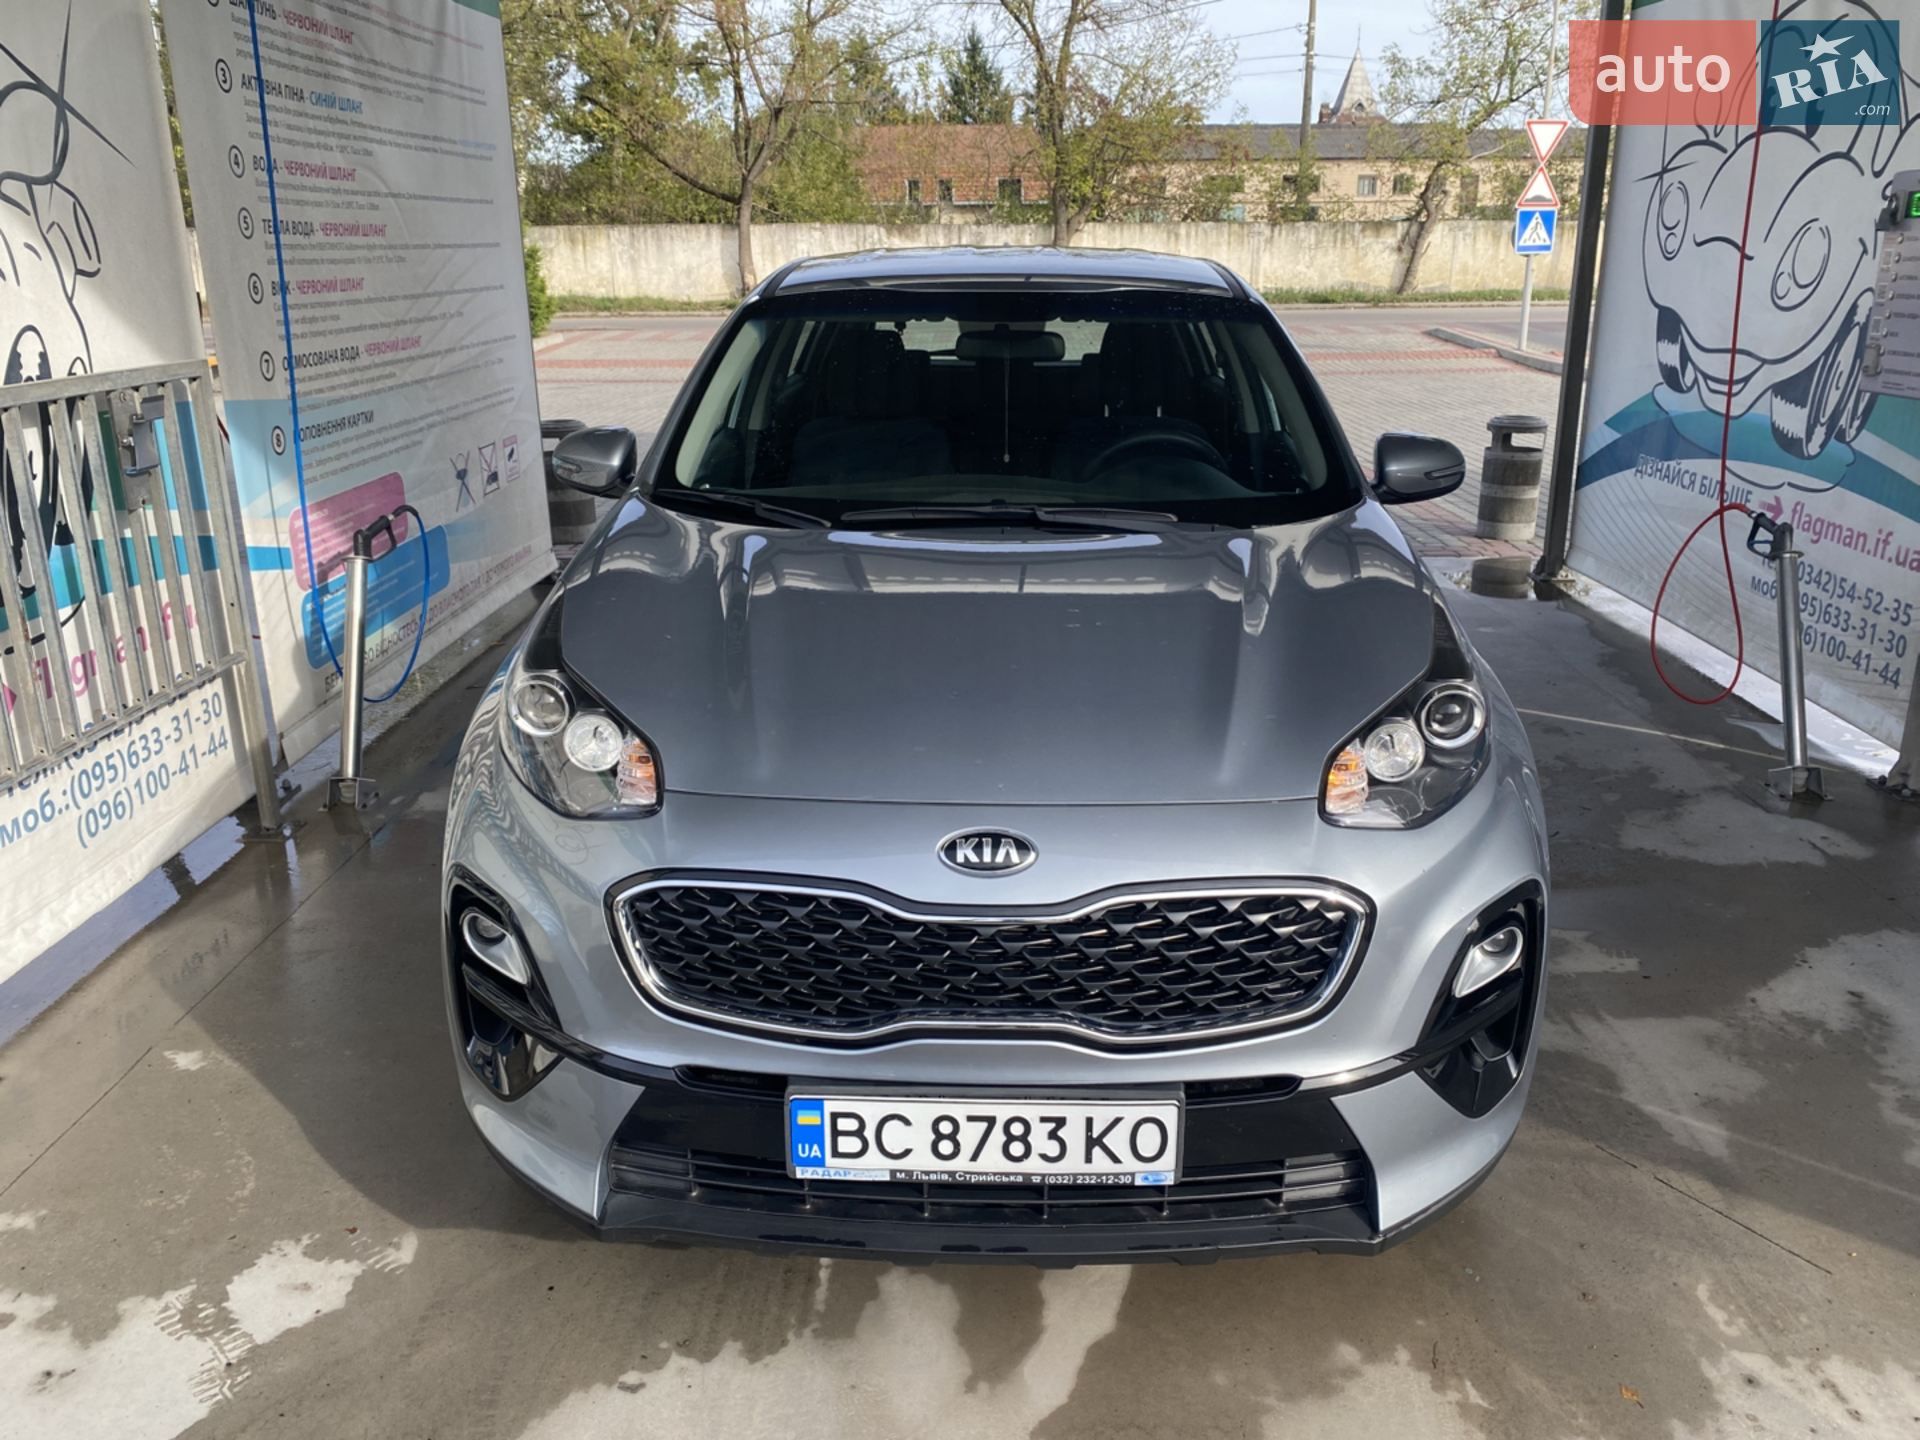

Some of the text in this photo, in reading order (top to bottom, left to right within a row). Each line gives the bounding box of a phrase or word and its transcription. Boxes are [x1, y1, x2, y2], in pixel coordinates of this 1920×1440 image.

[229, 0, 277, 20] АПУНЬ
[282, 8, 328, 36] ЧЕРВОНИЙ
[241, 73, 284, 99] АКТВНА
[284, 84, 305, 103] ПІНА
[309, 90, 337, 108] СИНІЙ
[338, 97, 363, 115] ШЛАНГ
[252, 155, 279, 174] ВОА
[284, 159, 328, 180] ЧЕРВОНИЙ
[328, 167, 357, 182] ШЛАНГ
[261, 218, 291, 236] ТЕЛА
[291, 220, 315, 240] ВОДА
[319, 219, 361, 237] ЧЕРВОНИЙ
[361, 223, 387, 238] ШЛАНГ
[271, 280, 291, 296] ВІК
[295, 275, 338, 295] ЧЕРВОНИЙ
[339, 277, 365, 293] ШЛАНГ
[282, 349, 339, 371] ОМОСОВАНА
[339, 345, 360, 362] ВОДА
[363, 336, 400, 357] ЧЕРВОНИЙ
[400, 335, 422, 352] ШЛАНГ
[294, 415, 346, 444] ОПОВНЕННЯ
[346, 409, 374, 430] КАРТКИ
[1634, 453, 1753, 505] ДІЗНАЙСЯ БІЛЬШЕ
[1790, 500, 1920, 574] flagman.if.ua
[1797, 560, 1913, 627] 0342)54-52-35
[78, 725, 229, 849] (096)100-41-44
[955, 837, 1021, 863] KIA
[797, 1143, 822, 1158] UA
[829, 1111, 1169, 1164] BC 8783 KO
[800, 1168, 851, 1178] РАДАР
[895, 1172, 909, 1180] м.
[912, 1171, 953, 1182] Львів,
[955, 1171, 1024, 1183] Стрийська
[1044, 1175, 1073, 1185] (032)
[1076, 1175, 1132, 1184] 232-12-30
